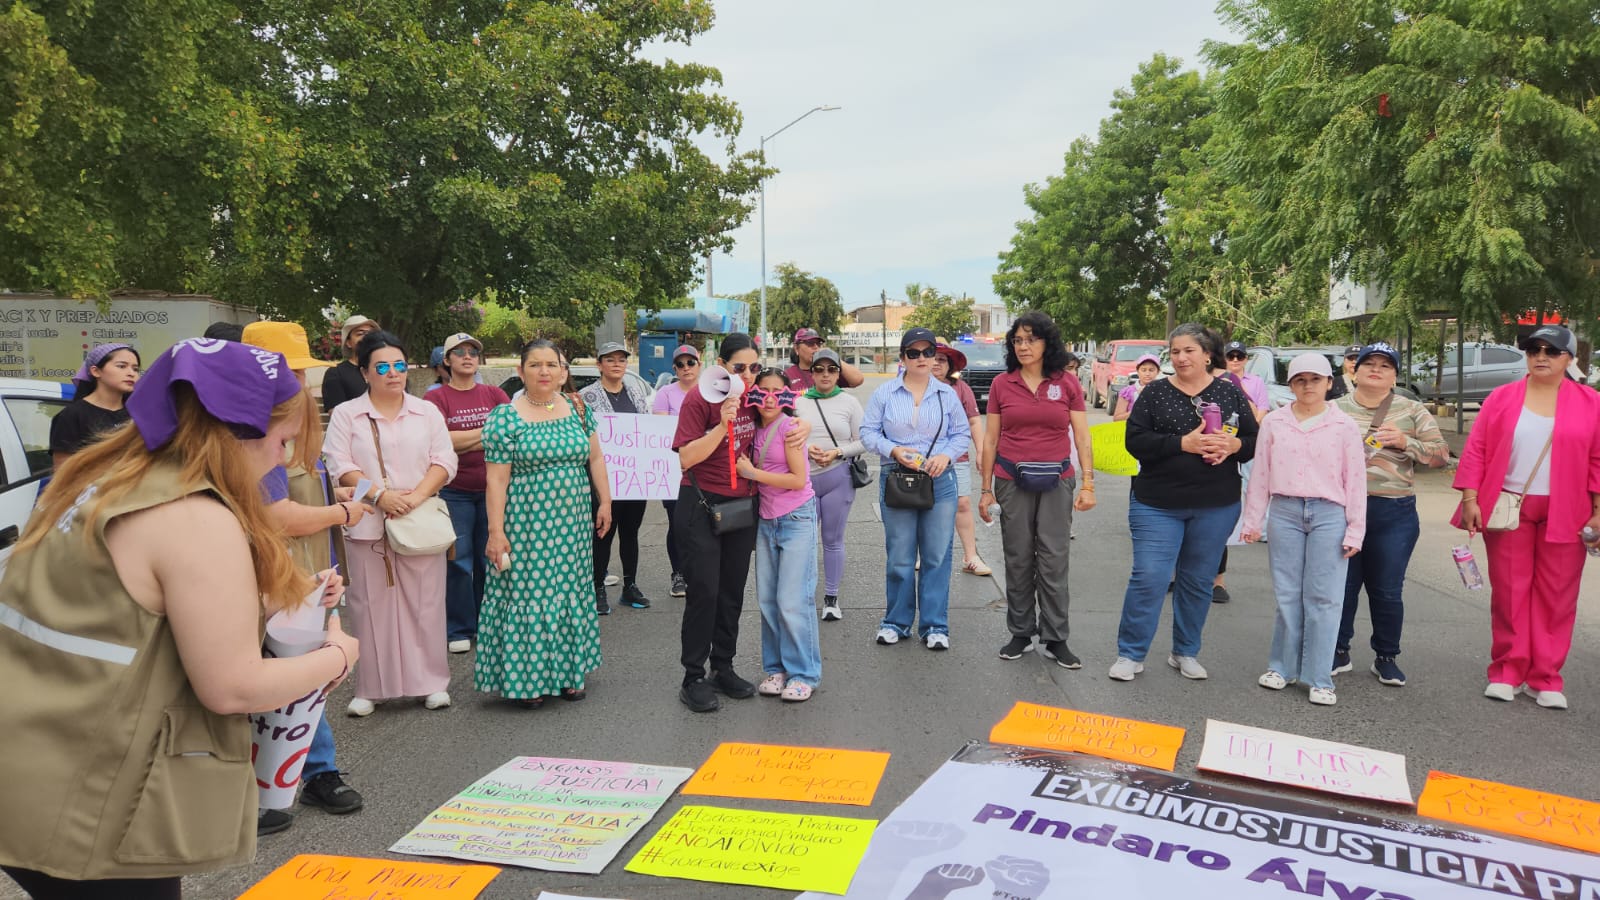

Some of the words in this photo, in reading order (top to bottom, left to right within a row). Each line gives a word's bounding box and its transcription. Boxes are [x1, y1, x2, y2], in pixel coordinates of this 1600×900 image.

[39, 310, 52, 322] Y
[55, 309, 169, 325] PREPARADOS
[92, 328, 137, 338] Chicles
[600, 415, 673, 449] Justicia
[1045, 776, 1271, 839] EXIGIMOS
[1279, 817, 1525, 895] JUSTICIA
